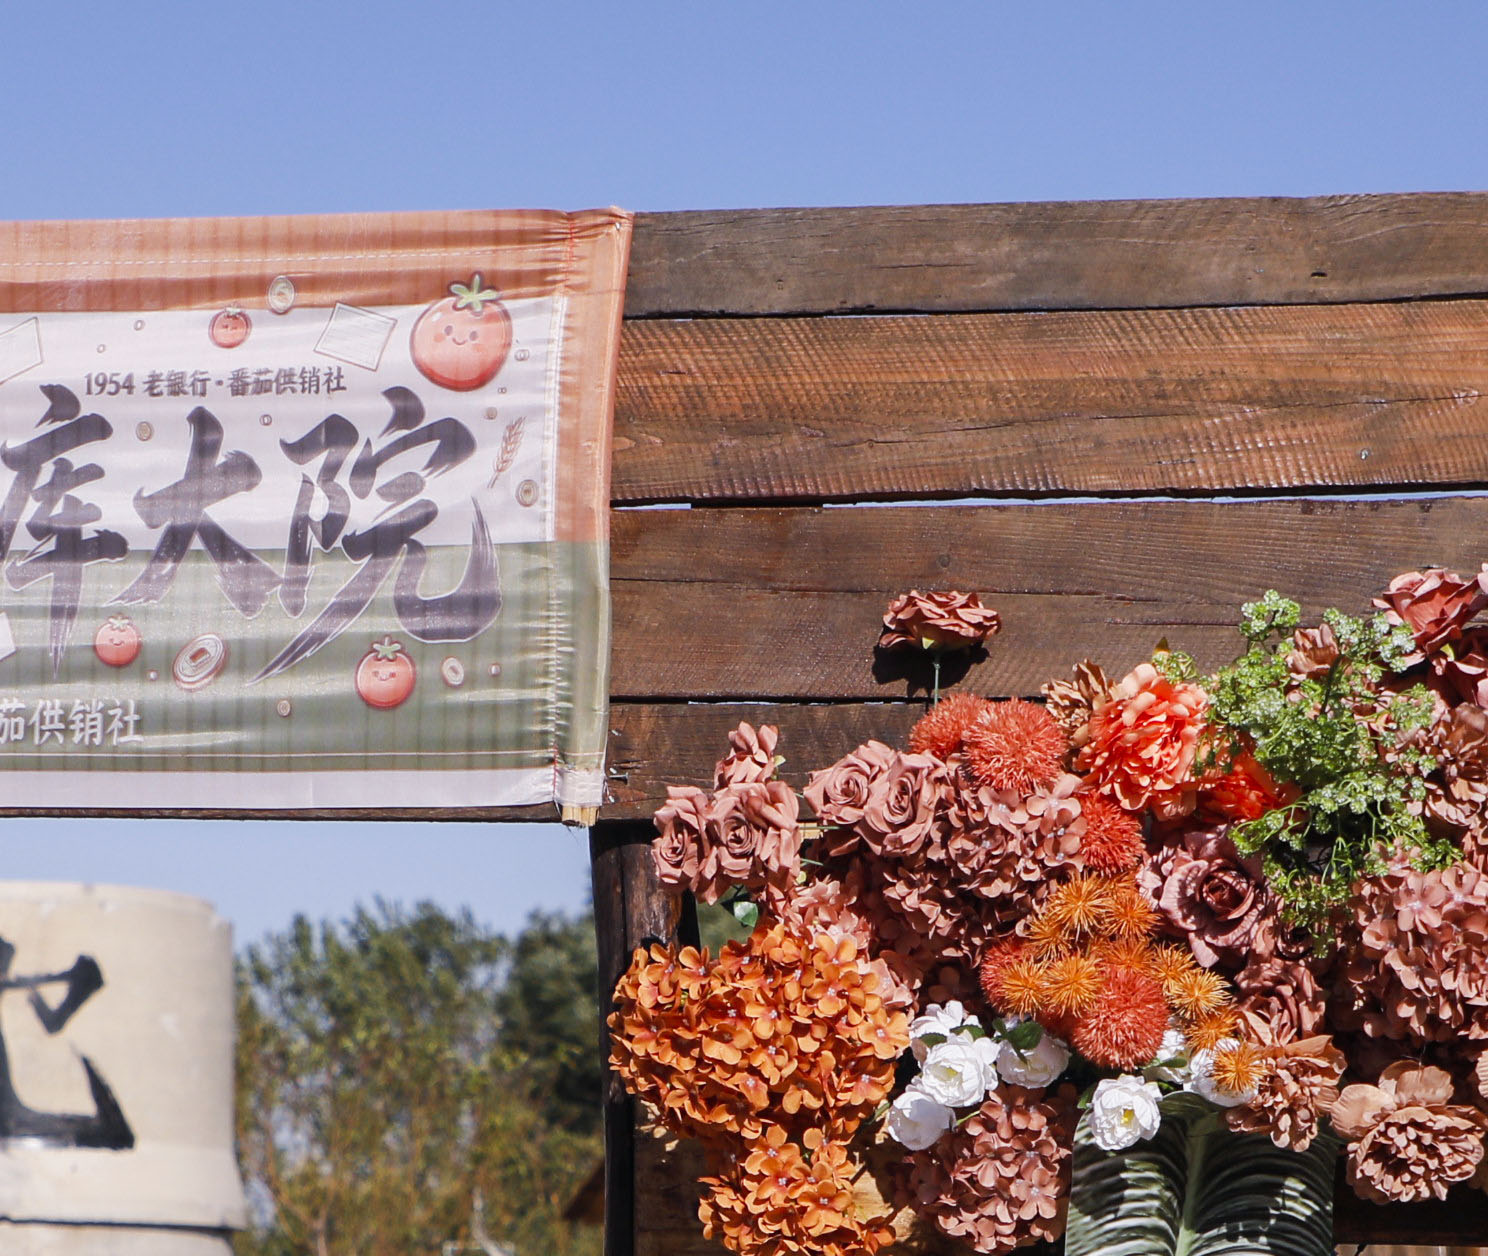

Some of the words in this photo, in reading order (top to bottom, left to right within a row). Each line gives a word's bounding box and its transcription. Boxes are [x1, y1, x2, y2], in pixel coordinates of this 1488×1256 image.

[84, 372, 135, 396] 1954
[143, 366, 347, 397] 老银行·番茄供销社
